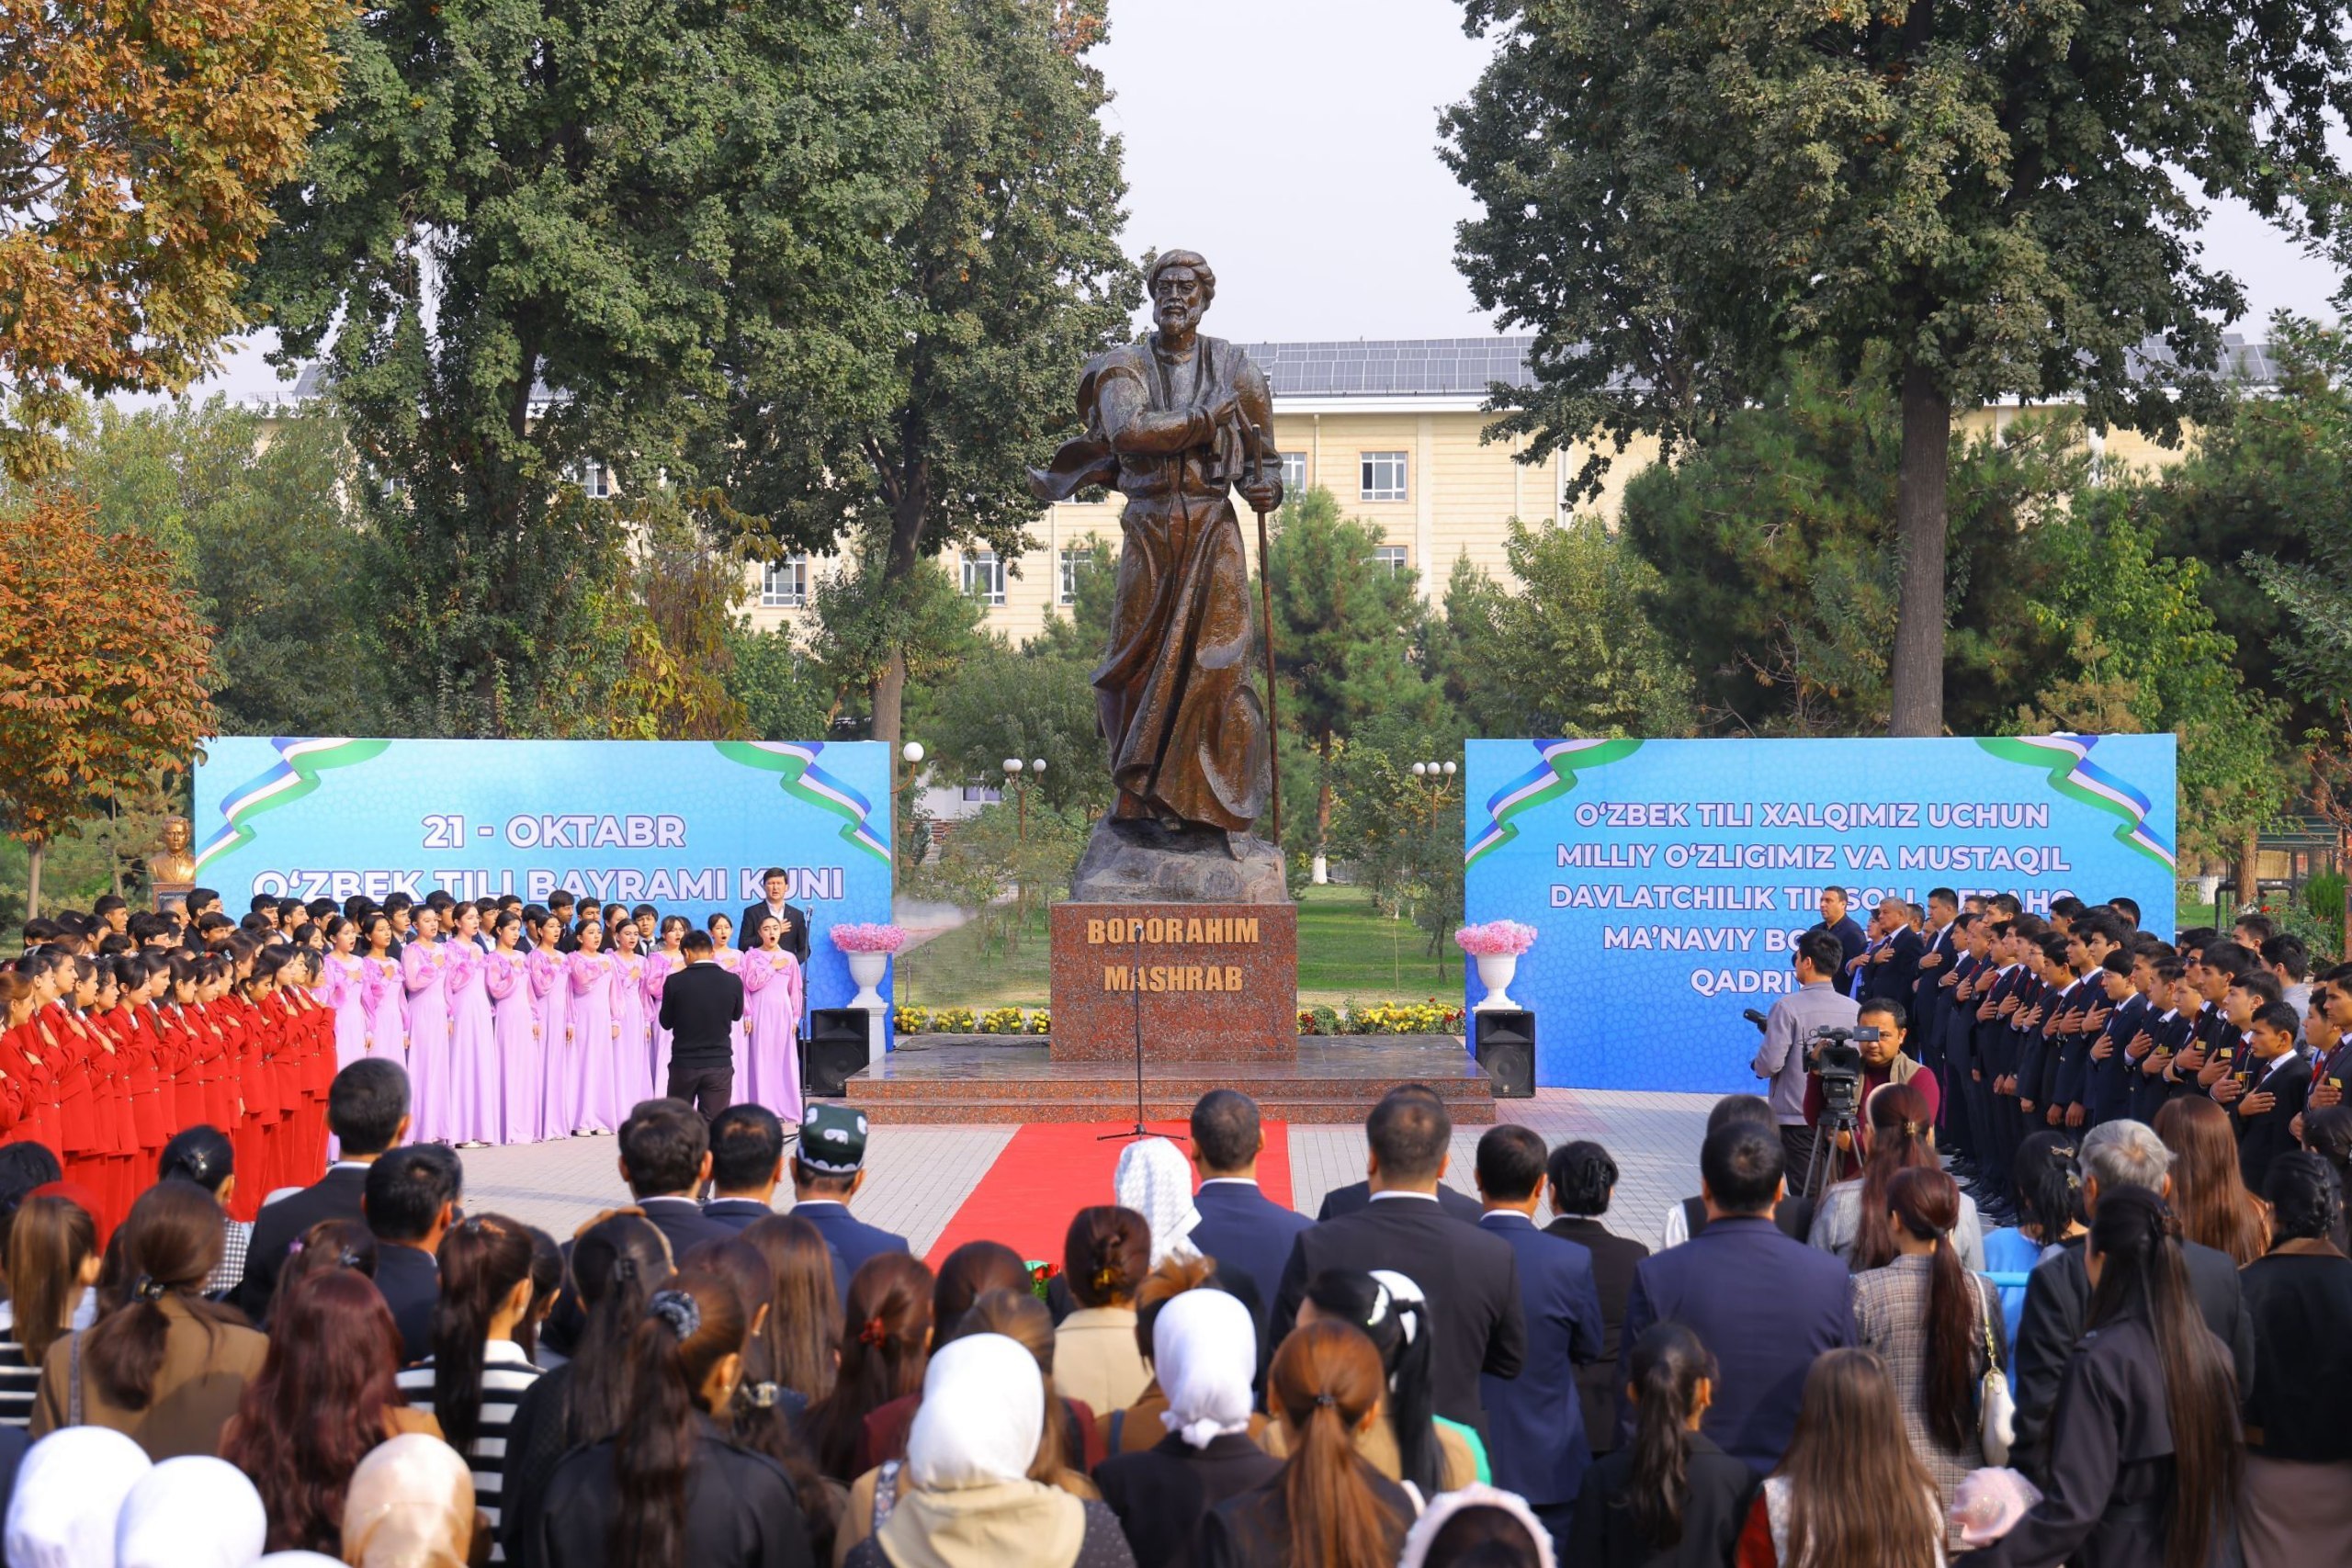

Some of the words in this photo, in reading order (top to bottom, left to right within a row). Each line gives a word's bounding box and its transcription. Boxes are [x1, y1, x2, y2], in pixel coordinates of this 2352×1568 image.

[1575, 802, 1690, 828] O‘ZBEK
[1697, 803, 1753, 827] TILI
[1760, 803, 1919, 831] XALQIMIZ
[1927, 803, 2050, 829] UCHUN
[422, 814, 465, 848] 21
[505, 814, 686, 848] OKTABR
[1556, 843, 1657, 867] MILLIY
[1664, 843, 1837, 869] O‘ZLIGIMIZ
[1844, 845, 1891, 870] VA
[1897, 845, 2071, 875] MUSTAQIL
[252, 869, 424, 905] O‘ZBEK
[434, 870, 514, 902] TILI
[527, 868, 728, 901] BAYRAMI
[1550, 885, 1776, 911] DAVLATCHILIK
[1087, 919, 1259, 944] BOBORAHIM
[1603, 926, 1757, 952] MA’NAVIY
[1105, 965, 1244, 992] MASHRAB
